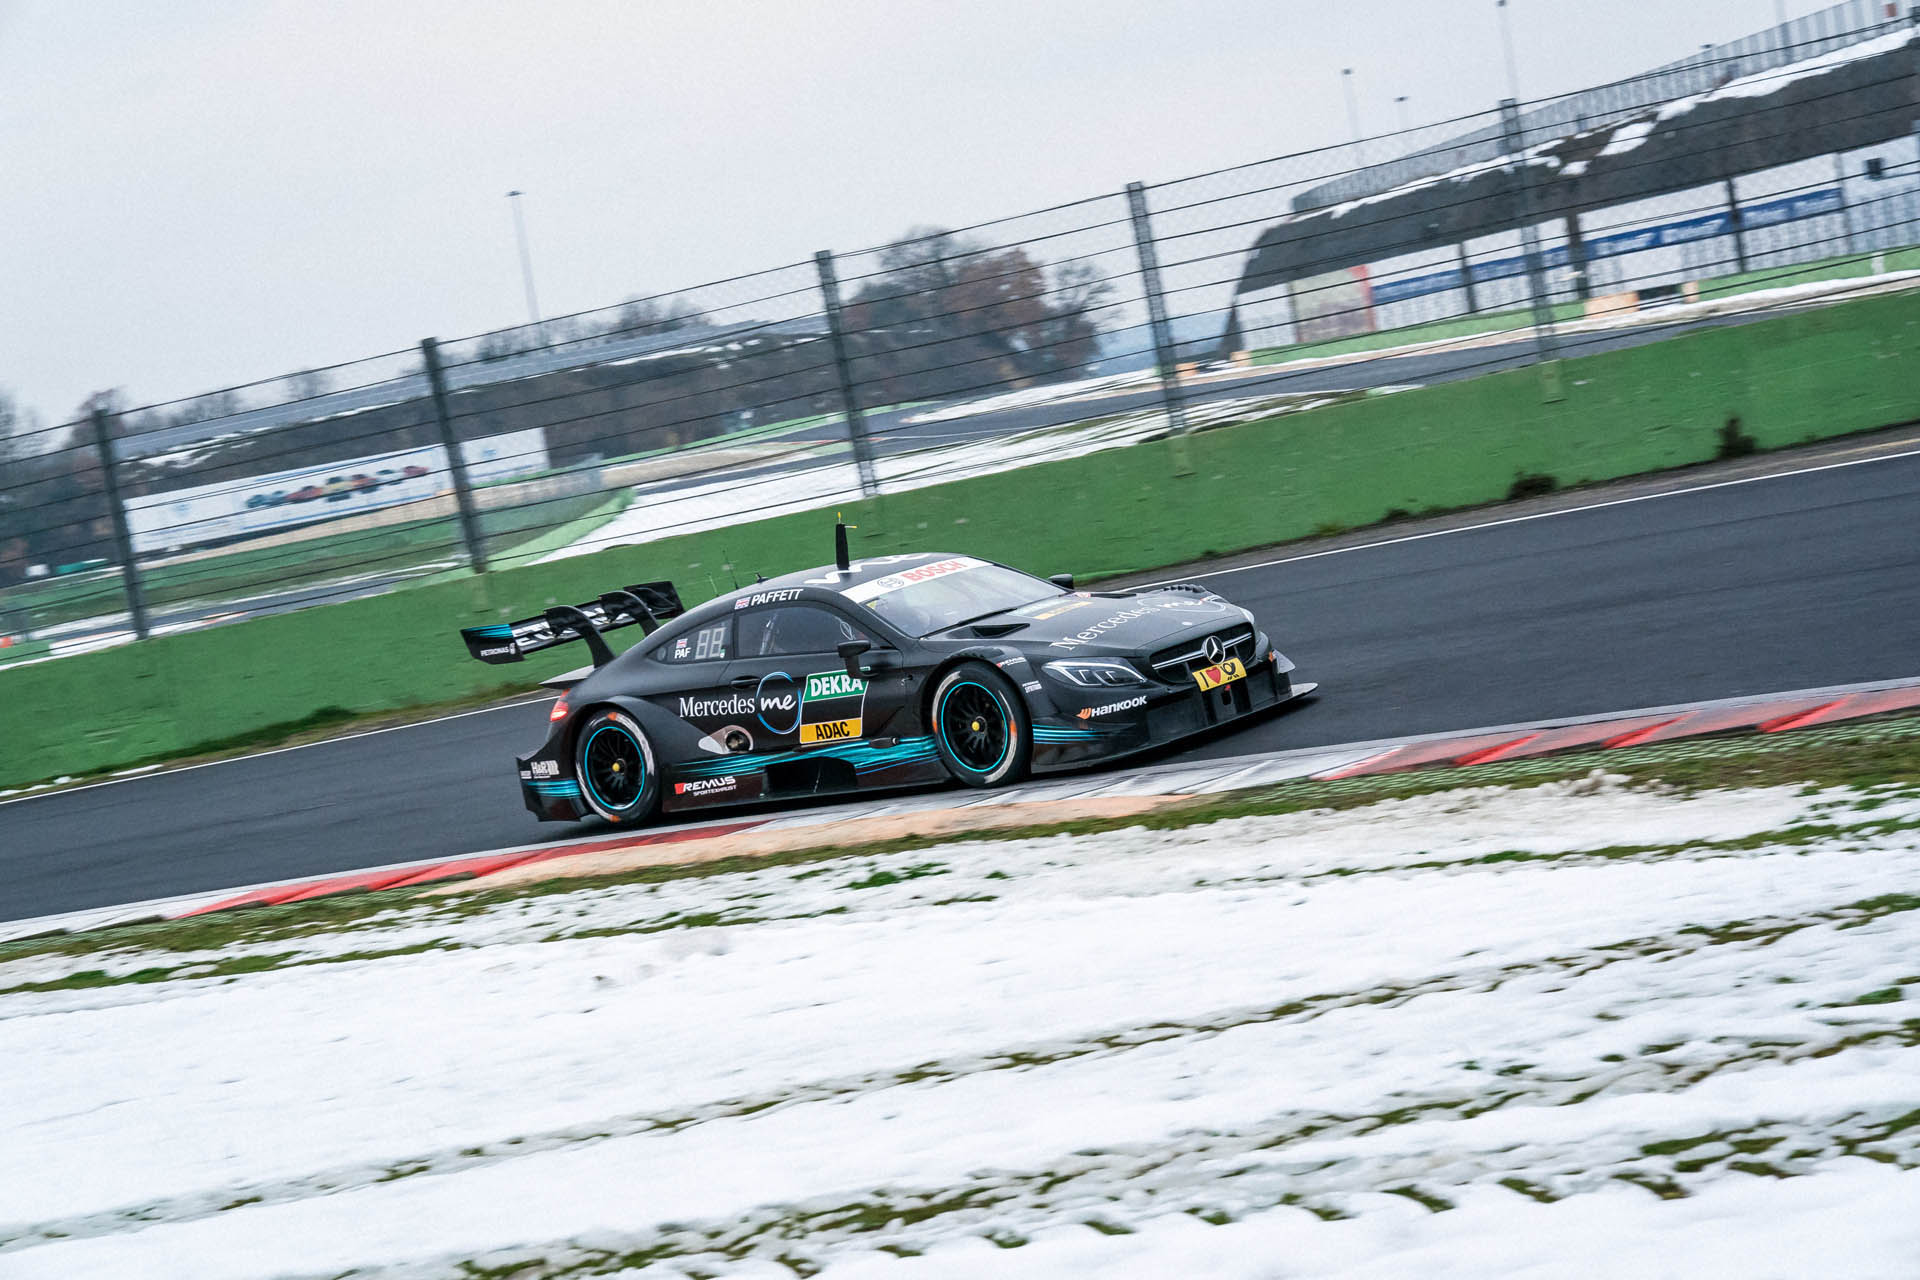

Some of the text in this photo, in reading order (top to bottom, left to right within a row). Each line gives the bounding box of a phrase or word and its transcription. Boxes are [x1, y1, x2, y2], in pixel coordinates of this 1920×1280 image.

[900, 560, 968, 582] BOSCH
[751, 588, 804, 606] PAFFETT
[1049, 606, 1160, 651] Mercedes
[480, 646, 510, 657] PETRONAS
[674, 647, 691, 659] PAF
[810, 675, 864, 697] DEKRA
[679, 694, 797, 718] Mercedes me
[815, 721, 850, 741] ADAC
[683, 775, 736, 792] REMUS
